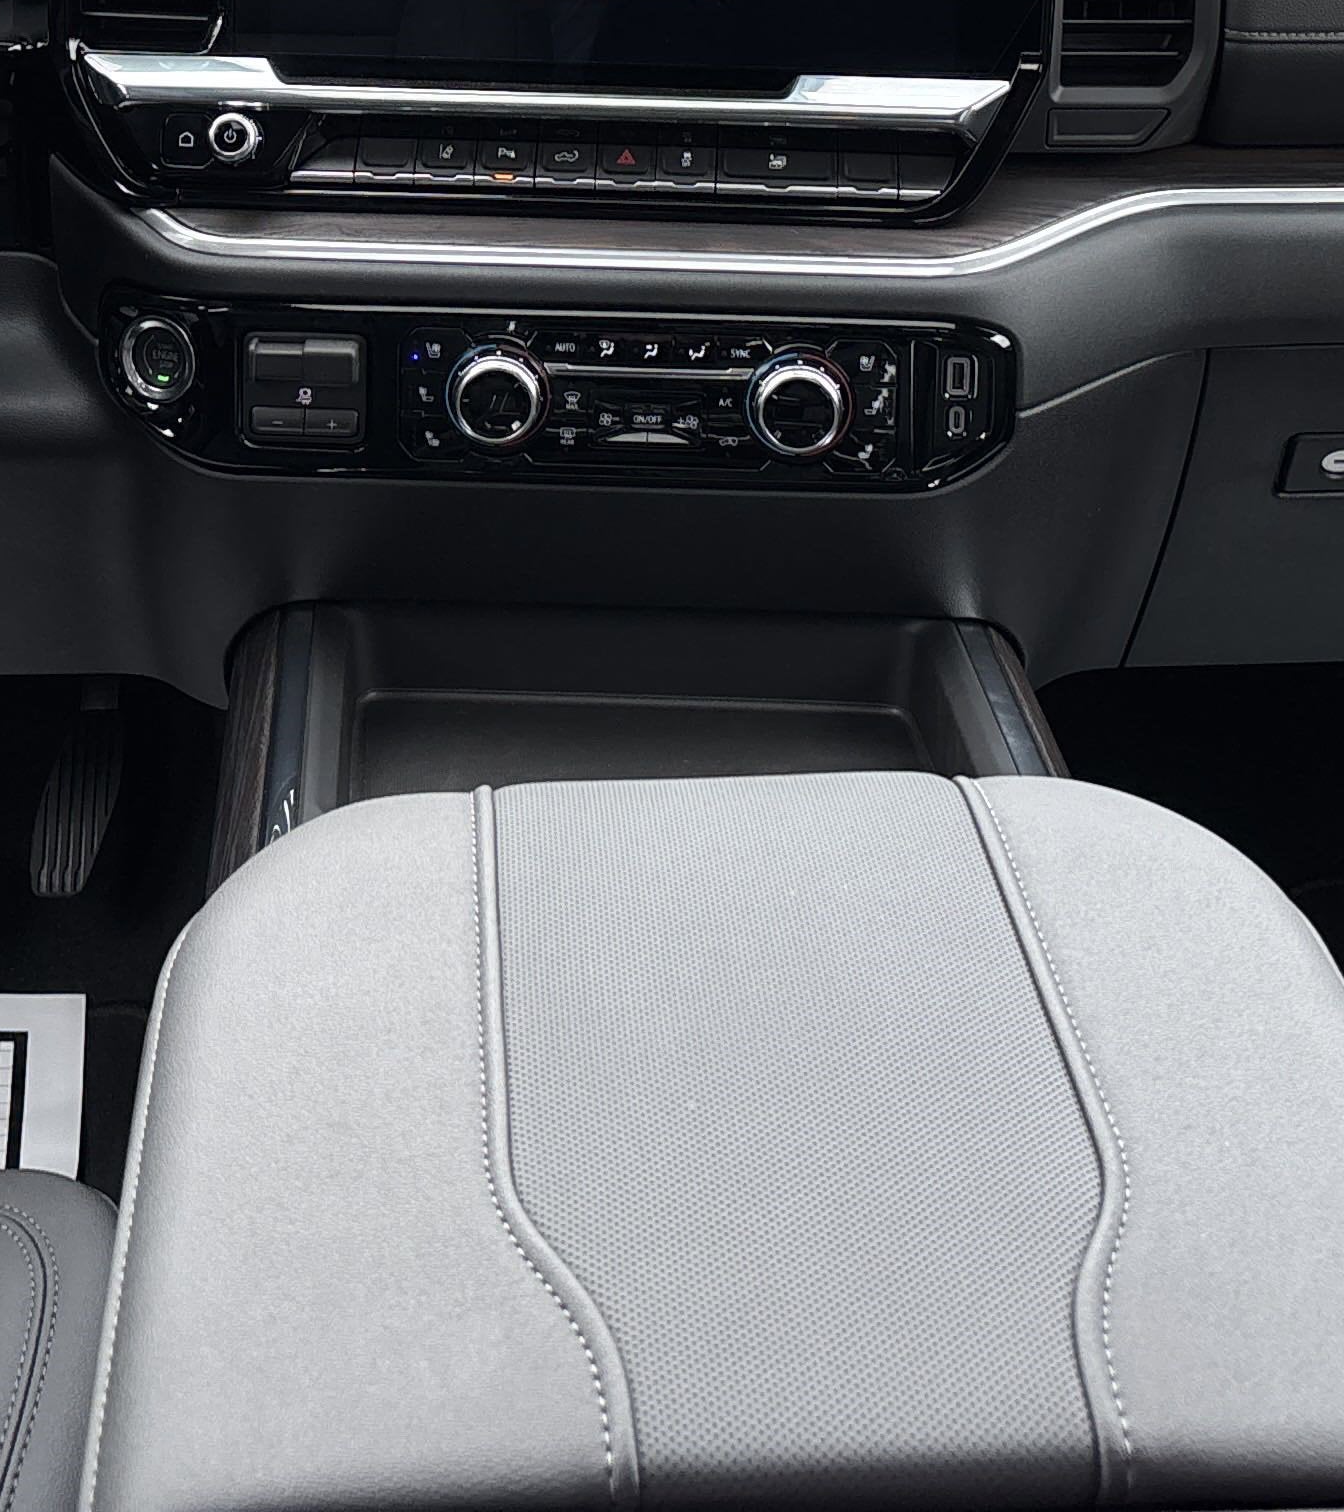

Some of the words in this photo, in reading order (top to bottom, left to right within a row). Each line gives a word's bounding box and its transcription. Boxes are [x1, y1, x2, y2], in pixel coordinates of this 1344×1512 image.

[554, 342, 576, 353] AUTO
[730, 348, 751, 359] SYNC
[718, 398, 733, 408] A/C
[632, 414, 662, 424] ON/OFF
